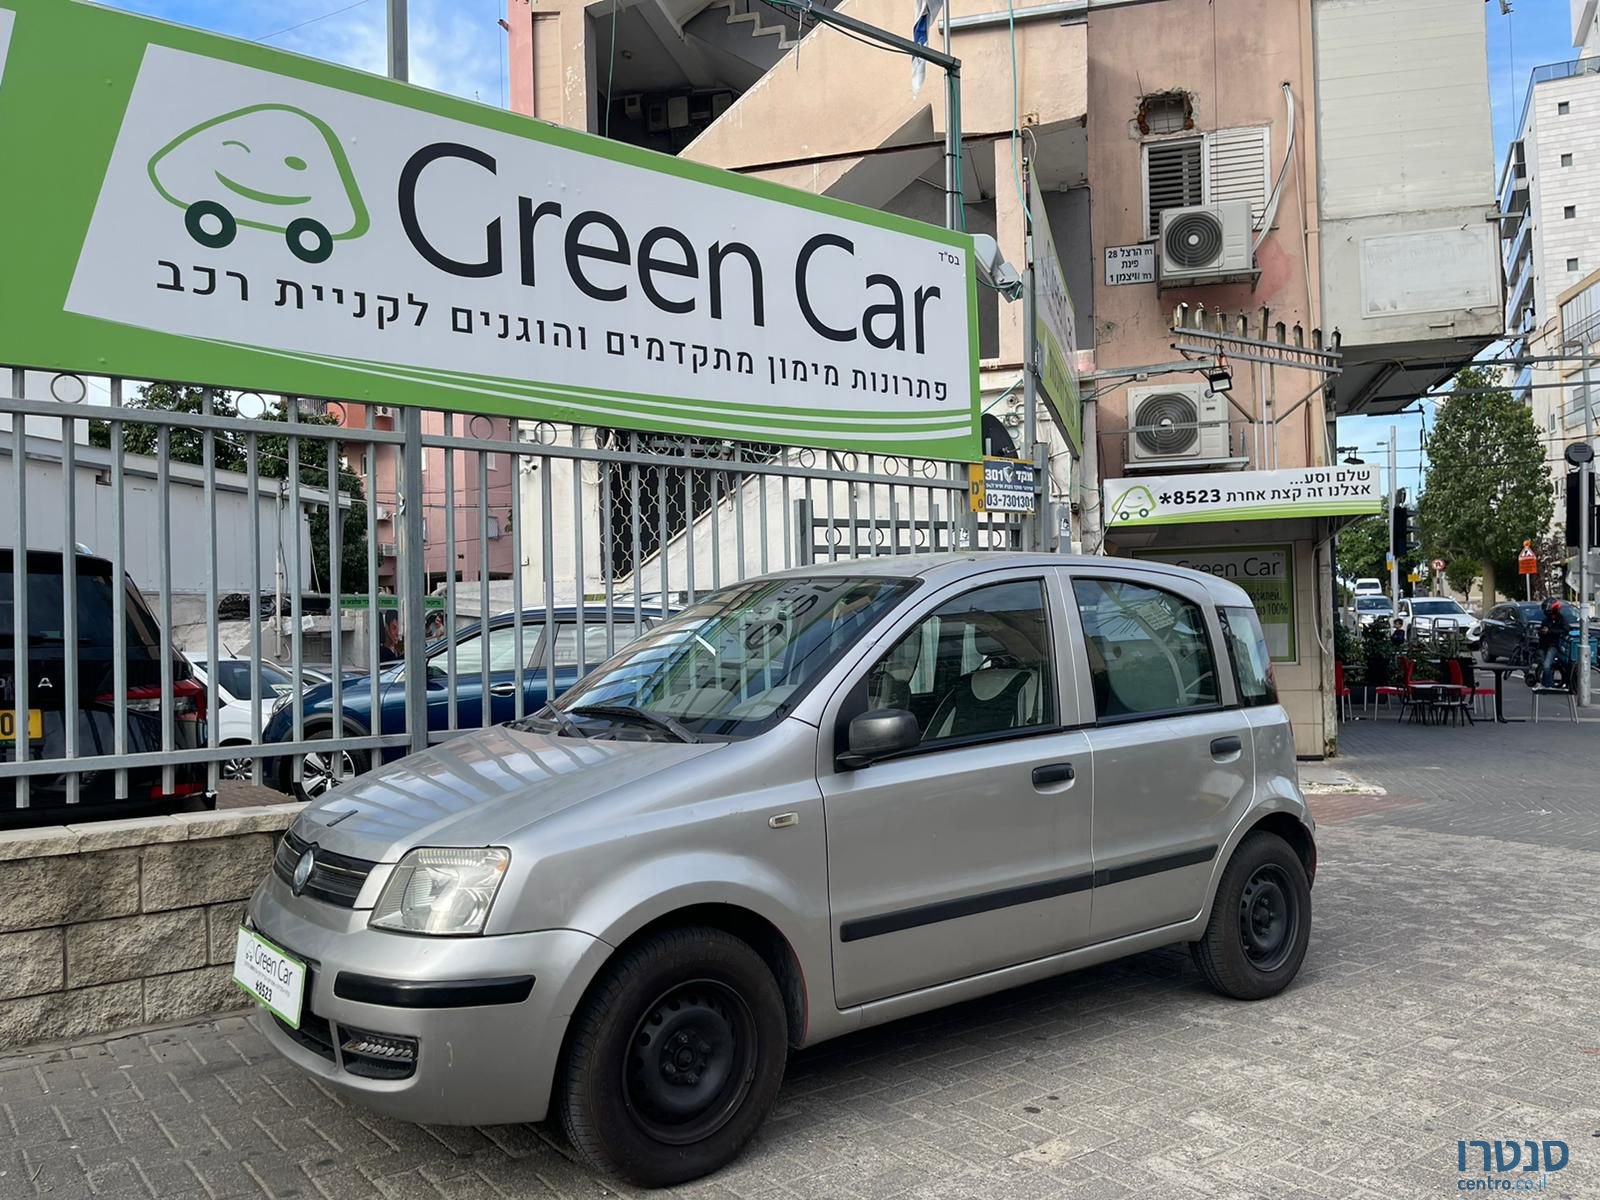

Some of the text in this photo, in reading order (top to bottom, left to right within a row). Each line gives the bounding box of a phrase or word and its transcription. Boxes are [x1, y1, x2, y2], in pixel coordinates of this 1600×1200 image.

[398, 142, 764, 327] Green
[795, 233, 941, 354] Car
[1108, 250, 1118, 259] 28
[1120, 247, 1142, 257] הרצל
[938, 251, 961, 266] בס"ד
[1121, 259, 1139, 269] פינת
[1109, 274, 1114, 282] 1
[157, 260, 947, 401] פתרונות מימון מתקדמים והוגנים לקניית רכב
[985, 468, 1004, 482] 301
[1336, 470, 1370, 482] שלם
[1226, 490, 1267, 503] אחרת
[1271, 488, 1302, 501] קצת
[1307, 486, 1324, 498] זה
[1328, 484, 1371, 497] אצלנו
[986, 493, 1034, 508] 03-7301301
[1244, 557, 1281, 577] Car
[255, 944, 278, 977] Green
[277, 959, 293, 986] Car
